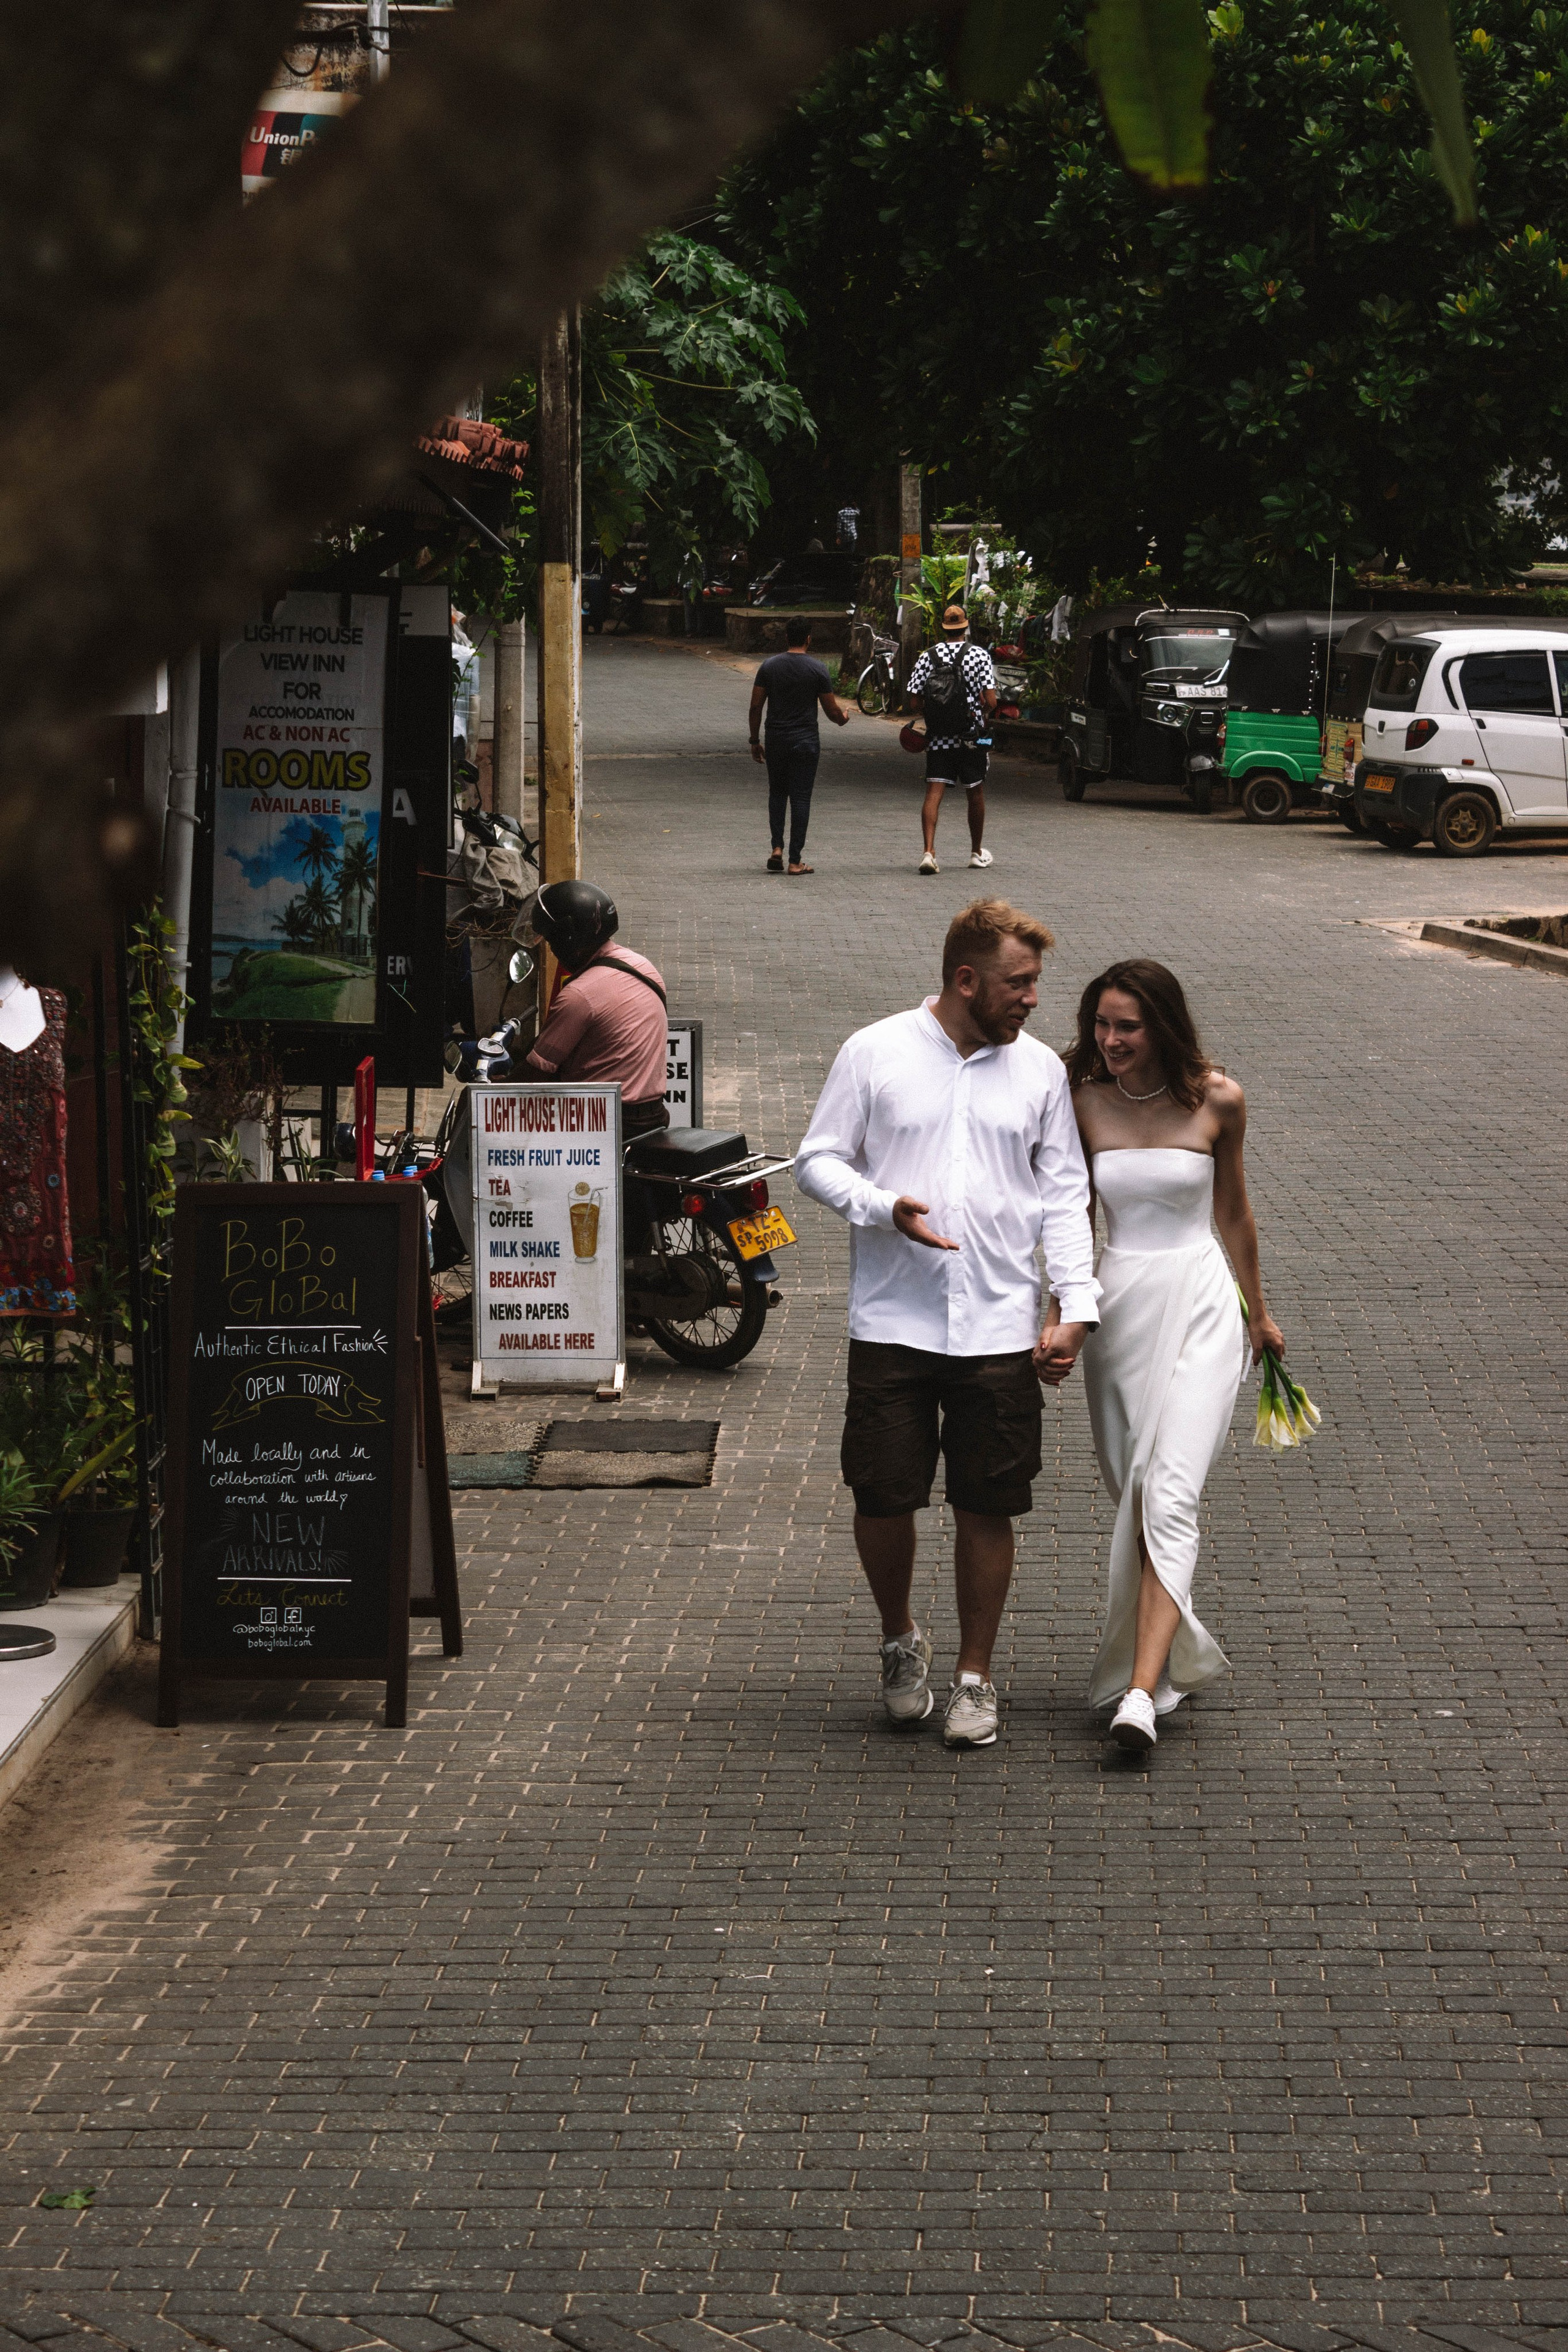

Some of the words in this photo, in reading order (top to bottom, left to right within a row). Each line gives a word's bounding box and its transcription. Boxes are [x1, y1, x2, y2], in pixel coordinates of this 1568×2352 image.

[244, 624, 296, 643] LIGHT
[300, 625, 364, 645] HOUSE
[261, 654, 310, 671] VIEW
[313, 654, 345, 673] INN
[283, 682, 321, 700] FOR
[1188, 687, 1207, 696] AAS
[249, 705, 355, 722] ACCOMODATION
[243, 724, 267, 741] AC
[270, 726, 281, 741] &
[285, 726, 323, 742] NON
[327, 727, 350, 743] AC
[222, 748, 372, 791] ROOMS
[250, 796, 341, 815] AVAILABLE
[485, 1098, 517, 1133] LIGHT
[519, 1098, 556, 1133] HOUSE
[558, 1098, 586, 1133] VIEW
[588, 1098, 606, 1132] INN
[488, 1149, 525, 1166] FRESH
[529, 1150, 562, 1166] FRUIT
[566, 1149, 600, 1166] JUICE
[489, 1179, 511, 1196] TEA
[489, 1211, 533, 1227] COFFEE
[737, 1231, 753, 1248] SP
[218, 1218, 336, 1283] BoBo
[489, 1241, 518, 1257] MILK
[522, 1241, 560, 1257] SHAKE
[489, 1272, 556, 1288] BREAKFAST
[489, 1303, 522, 1321] NEWS
[526, 1303, 569, 1321] PAPERS
[194, 1332, 261, 1357] Authentic
[267, 1335, 326, 1355] Ethical
[334, 1333, 377, 1352] Fashion
[499, 1333, 562, 1350] AVAILABLE
[564, 1333, 595, 1350] HERE
[246, 1376, 285, 1400] OPEN
[202, 1439, 243, 1466] Made
[251, 1442, 302, 1471] locally
[310, 1444, 341, 1460] and
[350, 1443, 371, 1459] in
[210, 1471, 296, 1487] collaboration
[305, 1470, 328, 1483] with
[335, 1471, 377, 1482] artisans
[225, 1493, 268, 1504] around
[277, 1492, 298, 1504] the
[306, 1490, 338, 1503] world
[254, 1512, 325, 1546] NEW
[281, 1583, 349, 1607] Connect
[233, 1624, 316, 1638] @boboglobalnyc
[248, 1637, 312, 1652] boboglobal.com
